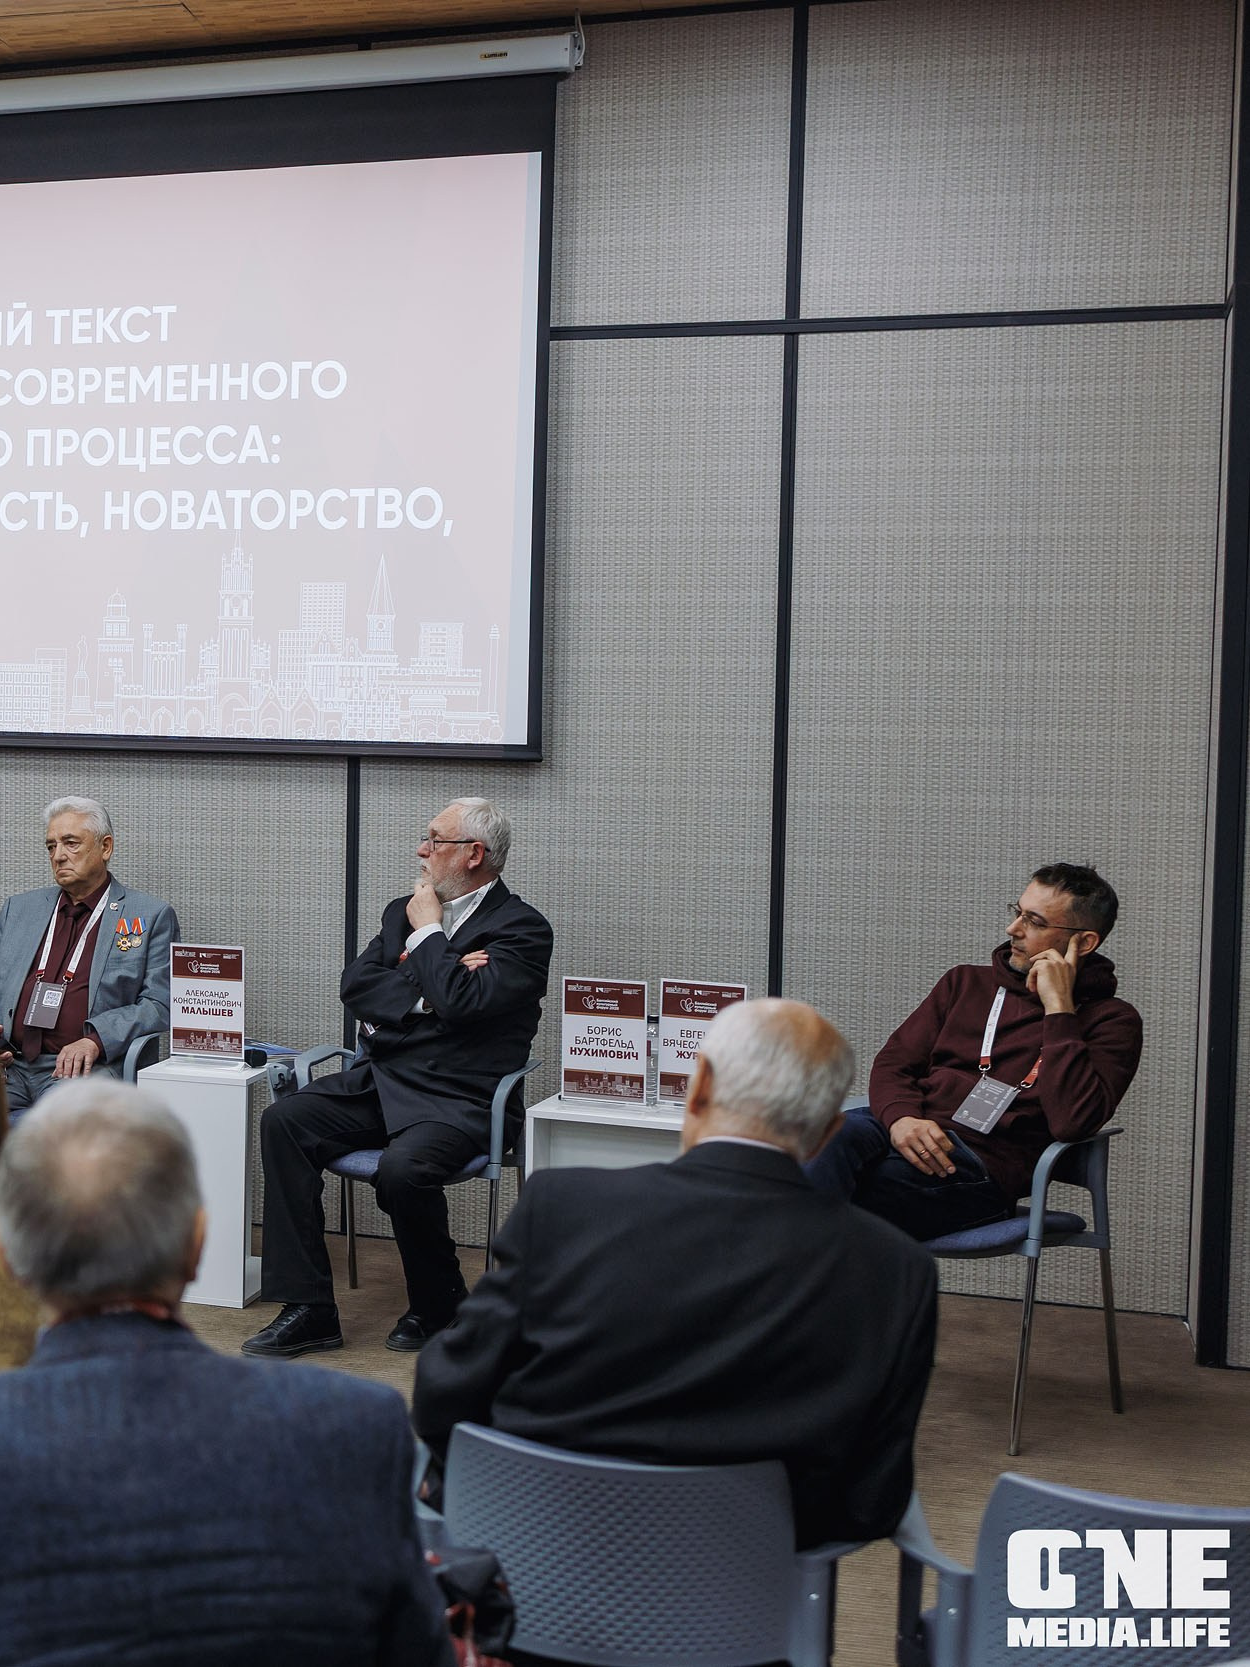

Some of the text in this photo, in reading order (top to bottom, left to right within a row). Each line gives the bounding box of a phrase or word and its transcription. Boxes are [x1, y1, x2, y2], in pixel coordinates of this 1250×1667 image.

[45, 305, 177, 345] ТЕКСТ
[27, 424, 281, 473] ПРОЦЕССА:
[104, 486, 453, 537] НОВАТОРСТВО,
[185, 989, 230, 999] АЛЕКСАНДР
[173, 998, 242, 1008] КОНСТАНТИНОВИЧ
[181, 1006, 234, 1017] МАЛЫШЕВ
[587, 1025, 622, 1037] БОРИС
[574, 1036, 635, 1050] БАРТФЕЛЬД
[570, 1047, 639, 1060] НУХИМОВИЧ
